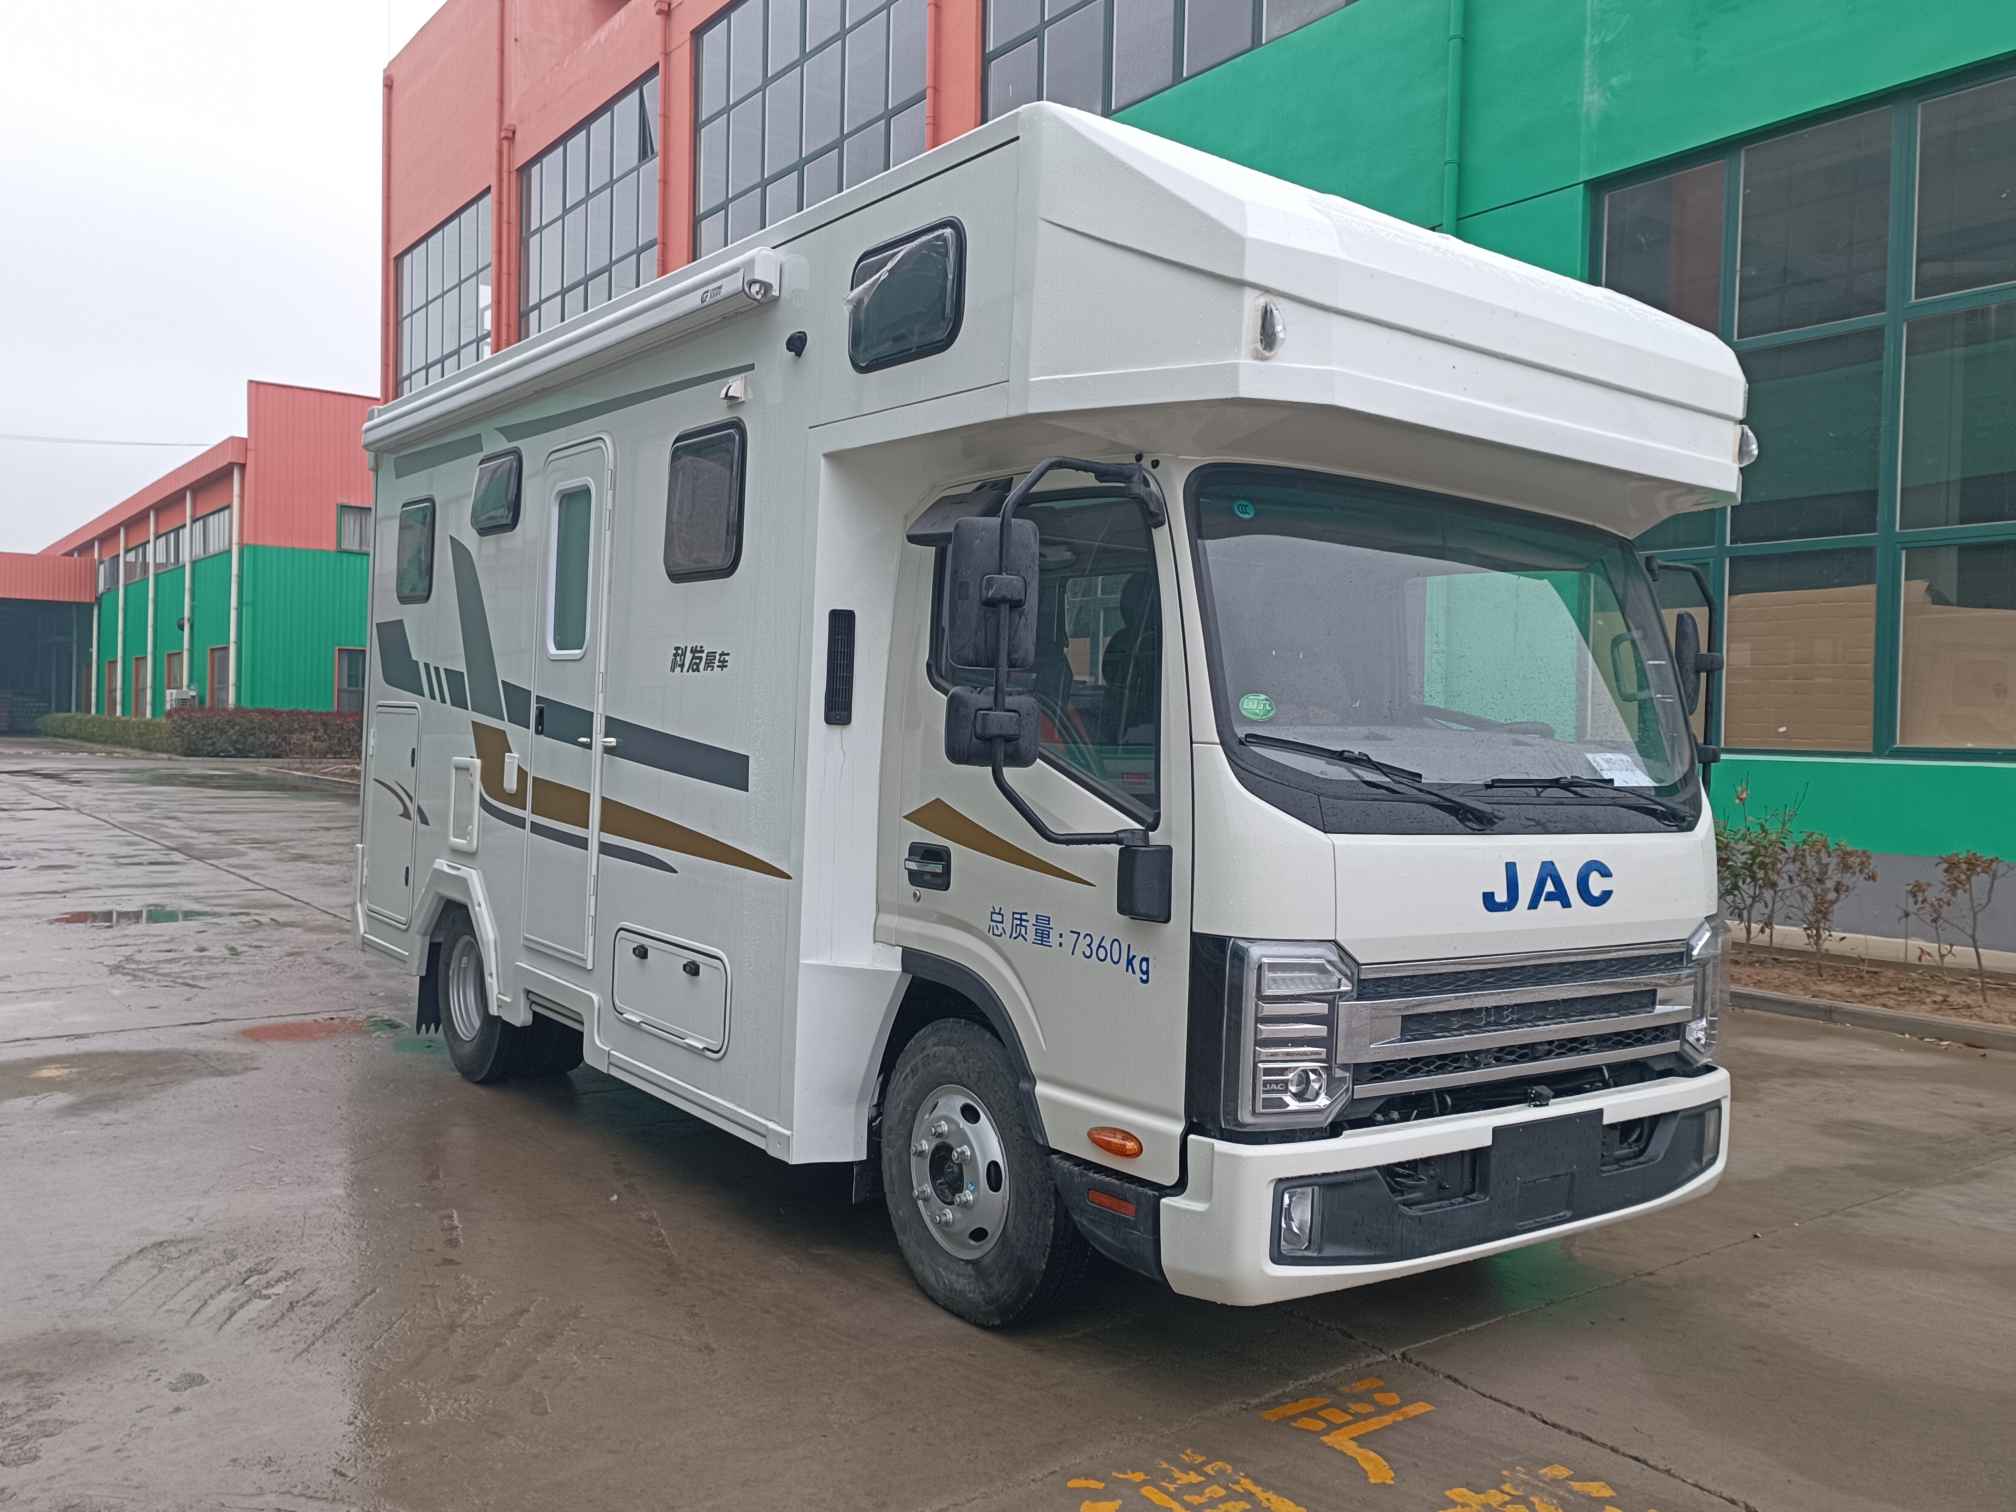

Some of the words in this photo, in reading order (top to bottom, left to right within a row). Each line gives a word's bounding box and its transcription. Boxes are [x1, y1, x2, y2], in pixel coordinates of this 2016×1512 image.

[670, 645, 731, 673] 科发房车
[1482, 859, 1614, 913] JAC
